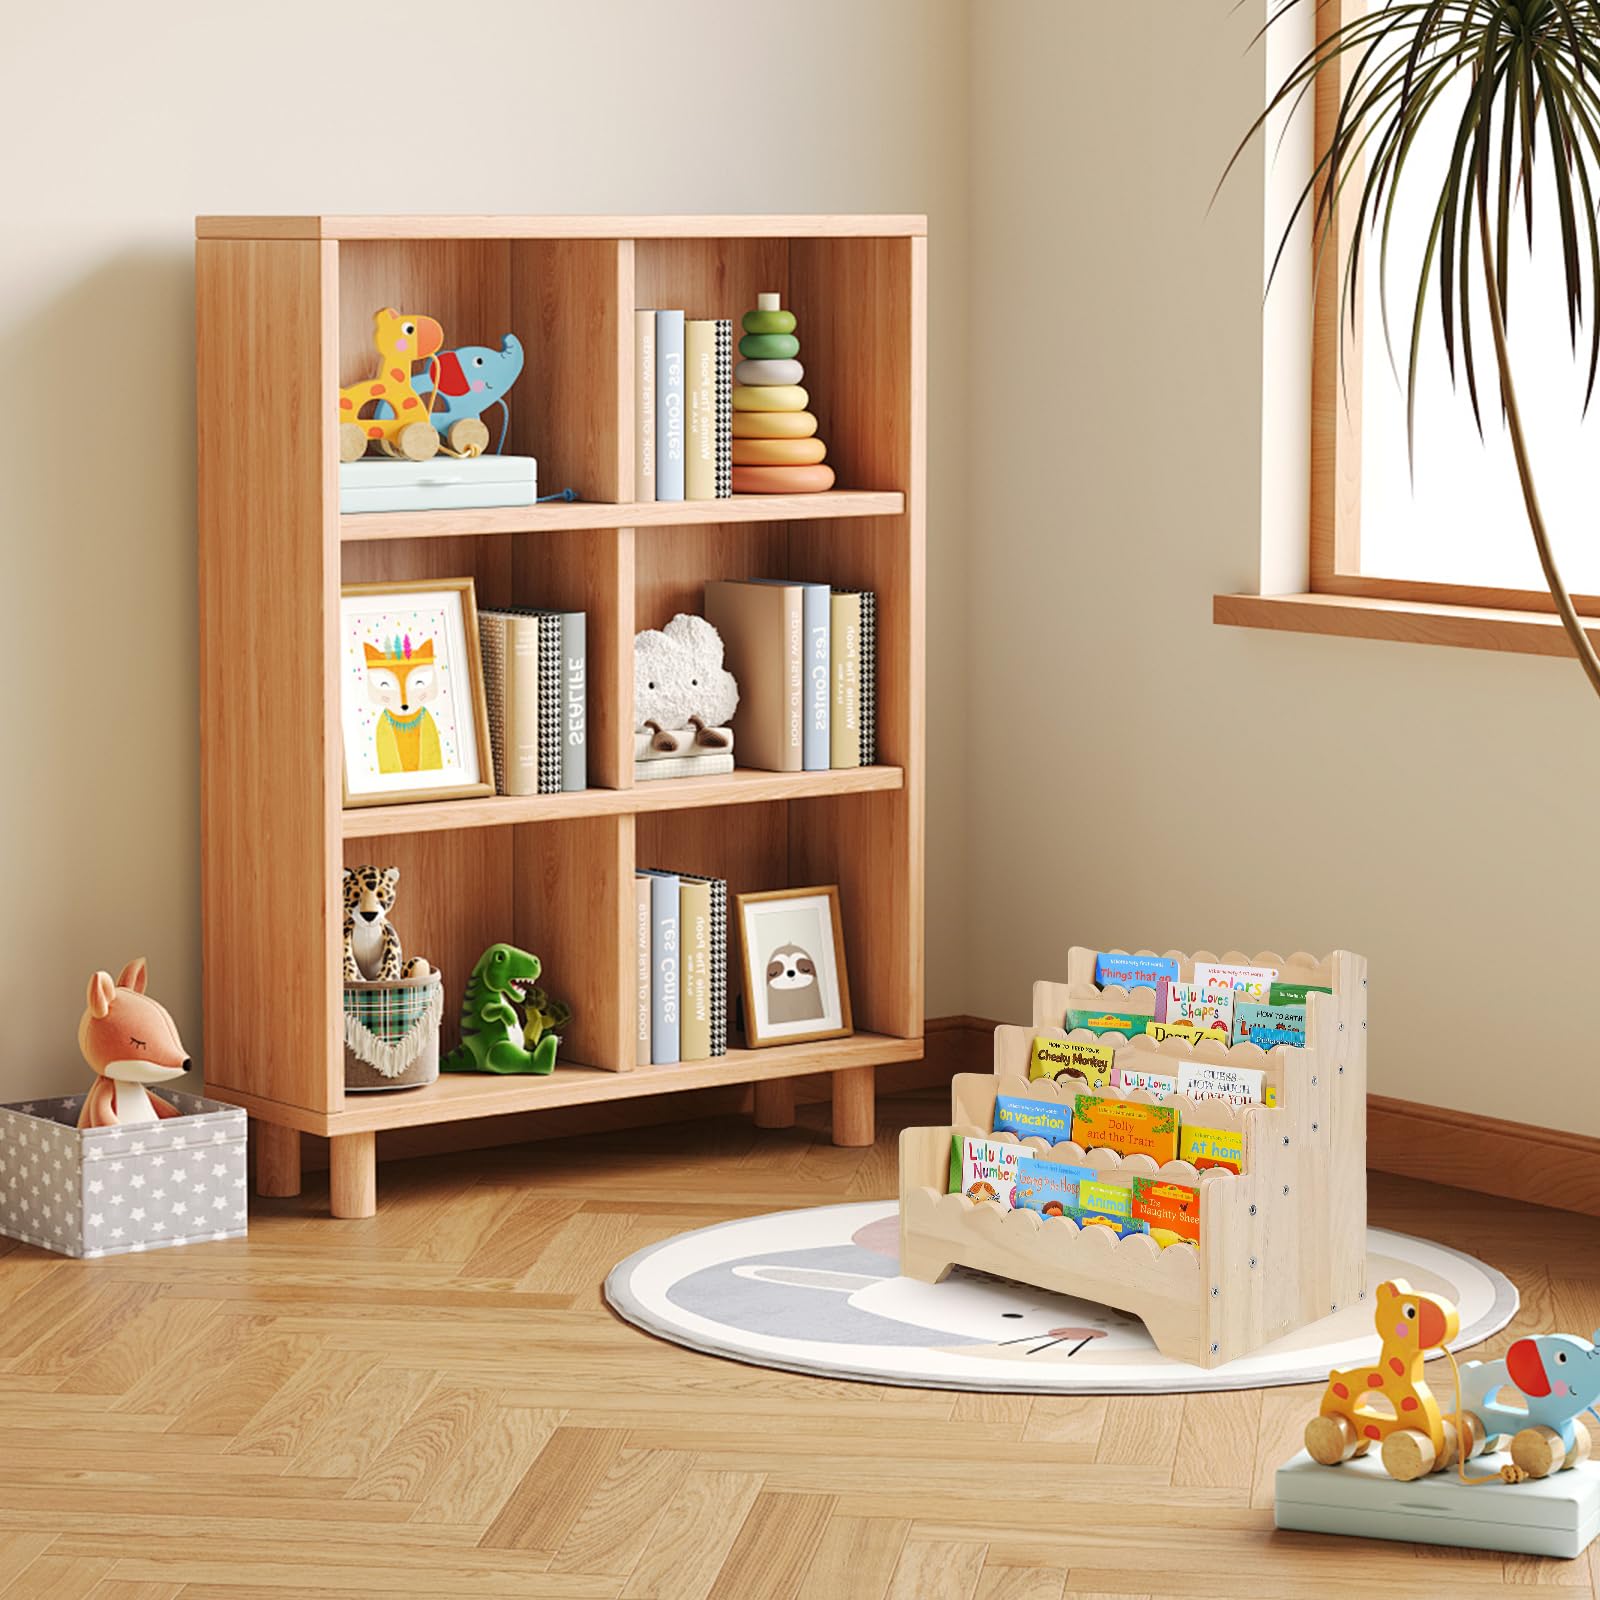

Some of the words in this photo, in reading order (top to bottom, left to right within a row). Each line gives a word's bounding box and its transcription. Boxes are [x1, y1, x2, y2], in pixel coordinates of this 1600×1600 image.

[1101, 967, 1133, 982] Things
[1135, 970, 1157, 982] that
[1173, 986, 1197, 1002] Lulu
[1201, 988, 1229, 1006] Loves
[1181, 1003, 1219, 1021] Shapes
[1256, 1010, 1274, 1018] HOW
[1275, 1012, 1284, 1020] TO
[1285, 1013, 1303, 1022] BATH
[1038, 1049, 1071, 1066] Cheeky
[1072, 1053, 1108, 1074] Monkey
[1124, 1073, 1145, 1087] Lulu
[1147, 1076, 1171, 1091] Loves
[1203, 1069, 1237, 1082] GUESS
[1188, 1079, 1214, 1090] HOW
[1217, 1083, 1250, 1094] MUCH
[1228, 1095, 1252, 1106] YOU
[1015, 1113, 1065, 1129] vacation
[1108, 1119, 1135, 1133] Dolly
[1087, 1130, 1106, 1140] and
[1109, 1132, 1125, 1142] the
[1128, 1135, 1155, 1147] Train
[969, 1142, 995, 1162] Lulu
[999, 1146, 1018, 1167] Lov
[1140, 1205, 1177, 1222] Naughty
